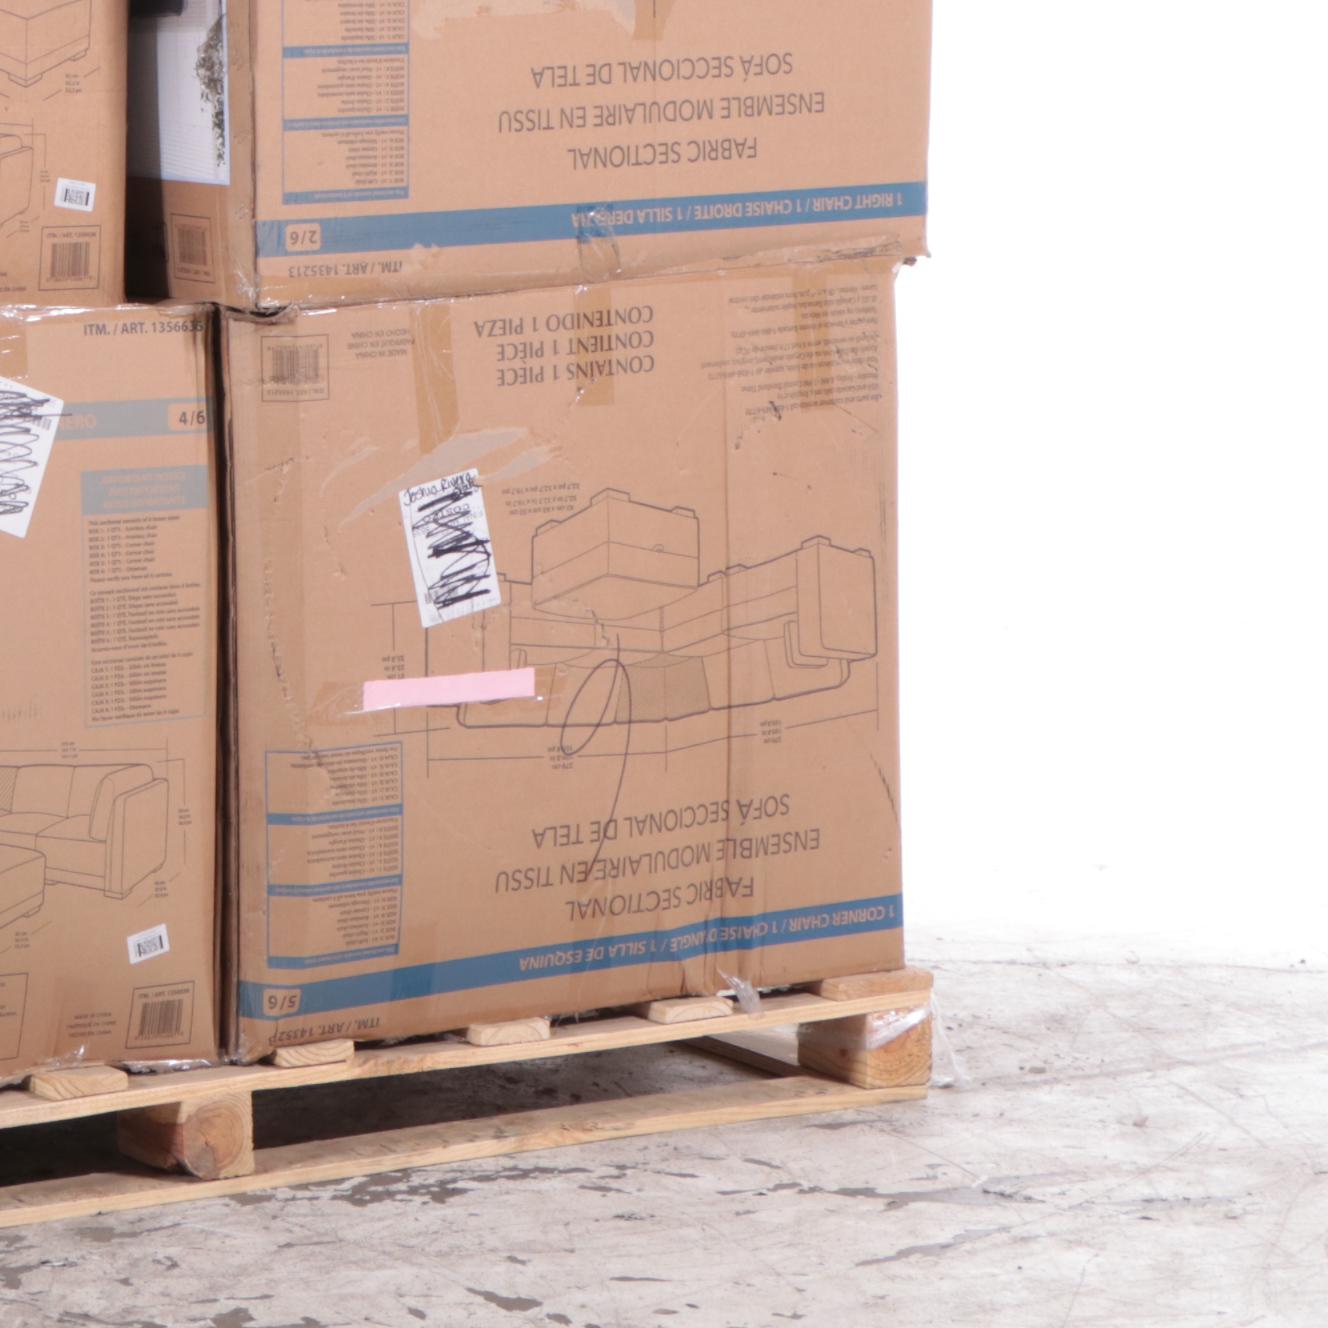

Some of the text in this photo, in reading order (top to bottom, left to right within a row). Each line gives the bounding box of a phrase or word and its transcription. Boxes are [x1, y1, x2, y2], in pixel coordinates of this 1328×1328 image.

[531, 52, 792, 89] SOFÁ SECCIONAL DE TELA
[498, 91, 824, 133] ENSEMBLE MODULAIRE EN TISSU
[568, 136, 756, 170] FABRIC SECTIONAL
[625, 193, 893, 224] RIGHT CHAIR CHAISE DROITE SILLA
[290, 230, 316, 244] 2/6
[83, 322, 147, 336] ITM. ART.
[473, 305, 653, 338] CONTENIDO PIEZA
[497, 330, 654, 364] CONTIENT PIÈCE
[497, 355, 654, 386] CONTAINS PIECE
[179, 410, 205, 425] 4/6
[532, 793, 789, 850] SOFÁ SECCIONAL DE TELA
[495, 826, 820, 893] ENSEMBLE MODULAIRE EN TISSU
[566, 874, 754, 922] FABRIC SECTIONAL
[519, 905, 885, 971] CORNER CHAIR CHAISE SILLA ESQUINA
[268, 994, 295, 1009] 5/6
